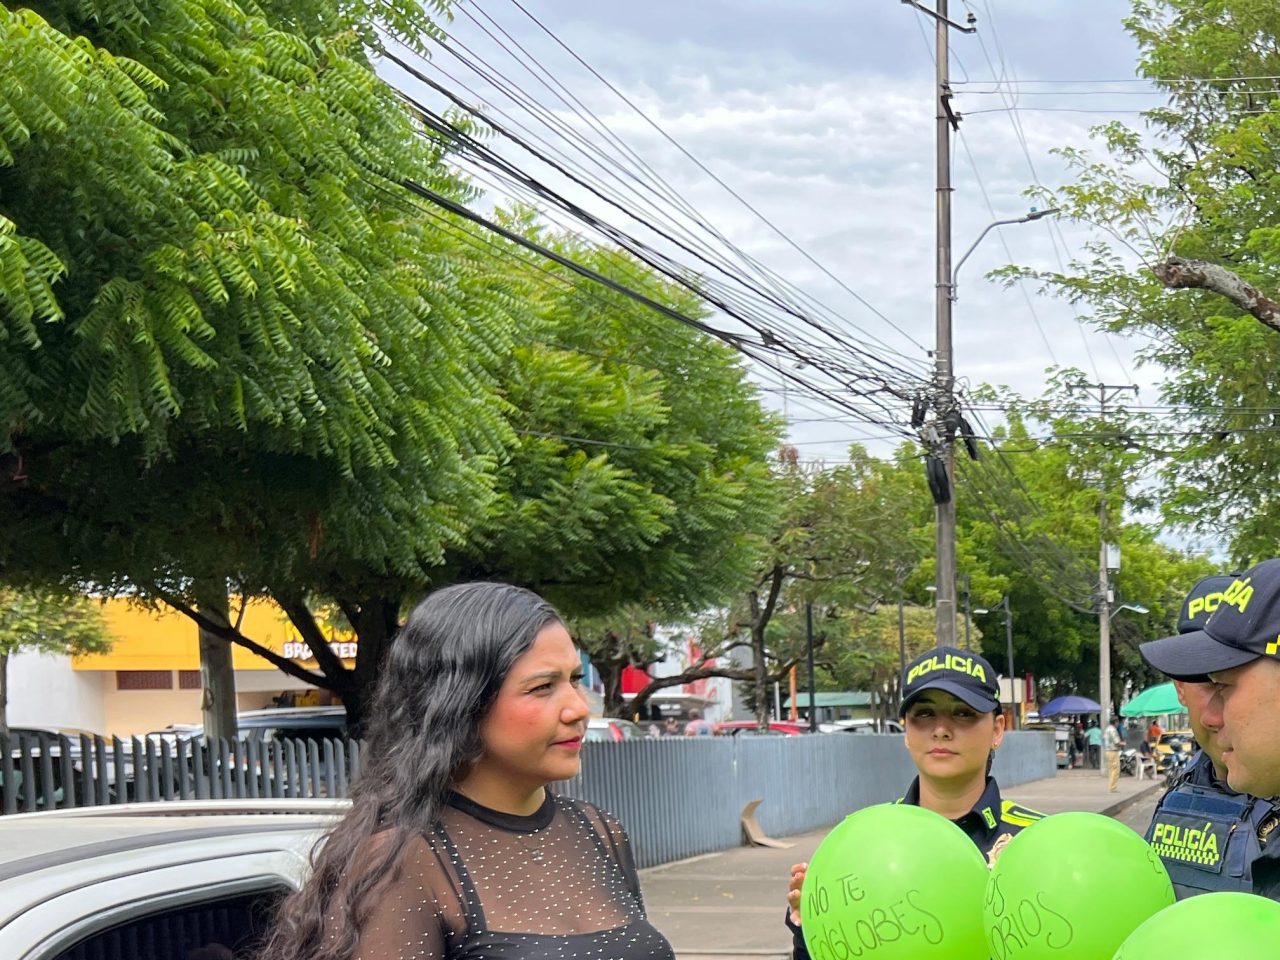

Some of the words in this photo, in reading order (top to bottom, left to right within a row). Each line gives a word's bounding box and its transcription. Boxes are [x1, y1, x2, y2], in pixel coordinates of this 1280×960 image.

[907, 654, 987, 685] POLICÍA
[1153, 823, 1218, 854] POLICÍA
[808, 876, 829, 919] NO
[835, 873, 865, 906] TE
